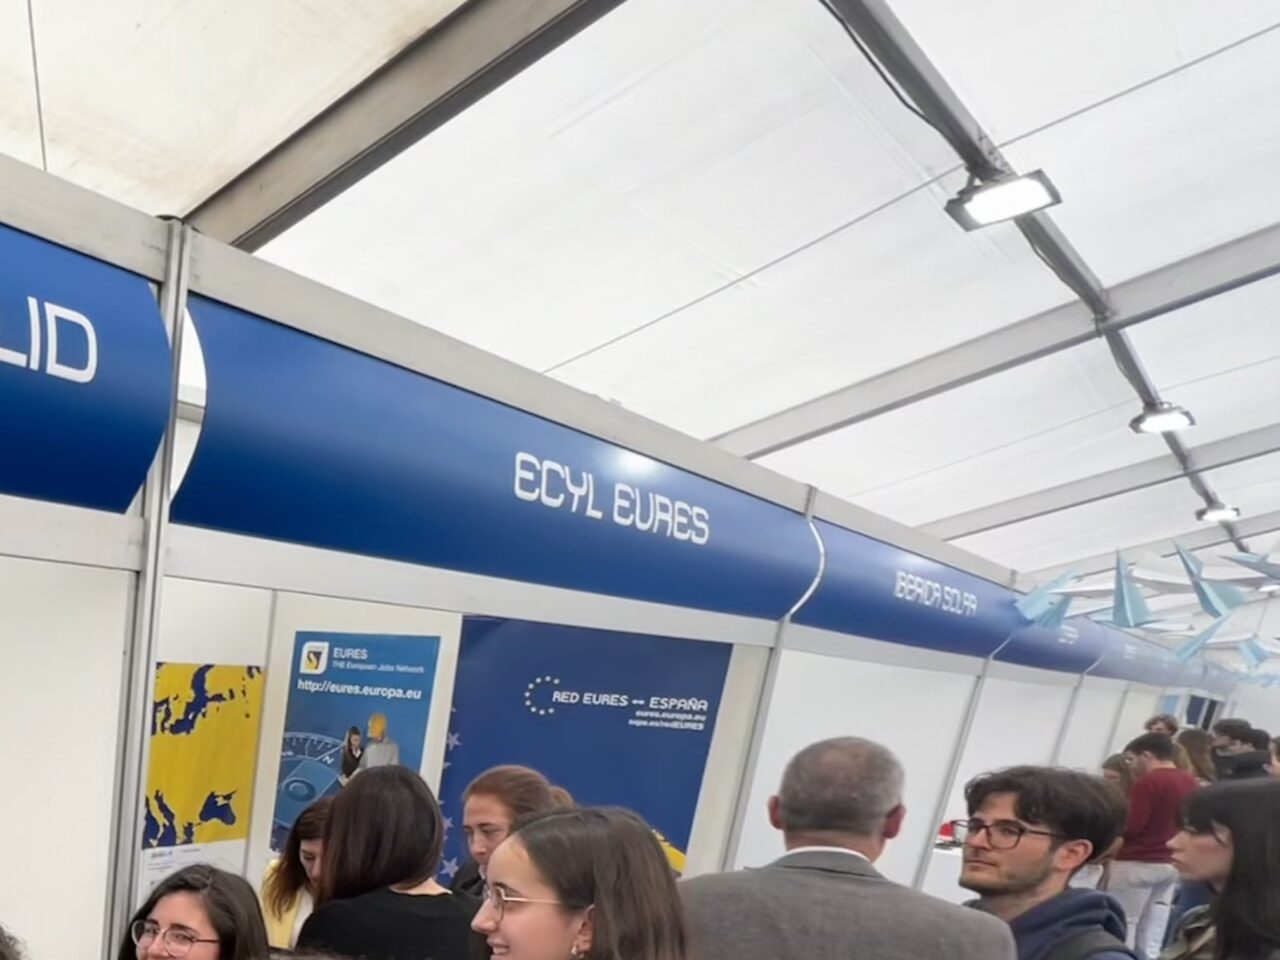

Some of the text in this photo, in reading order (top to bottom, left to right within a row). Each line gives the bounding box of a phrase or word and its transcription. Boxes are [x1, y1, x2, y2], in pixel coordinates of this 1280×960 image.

[513, 452, 710, 545] ECYL EURES
[333, 647, 368, 660] EURES
[297, 678, 422, 700] http://eures.europa.eu
[552, 691, 709, 712] RED EURES ESPAÑA
